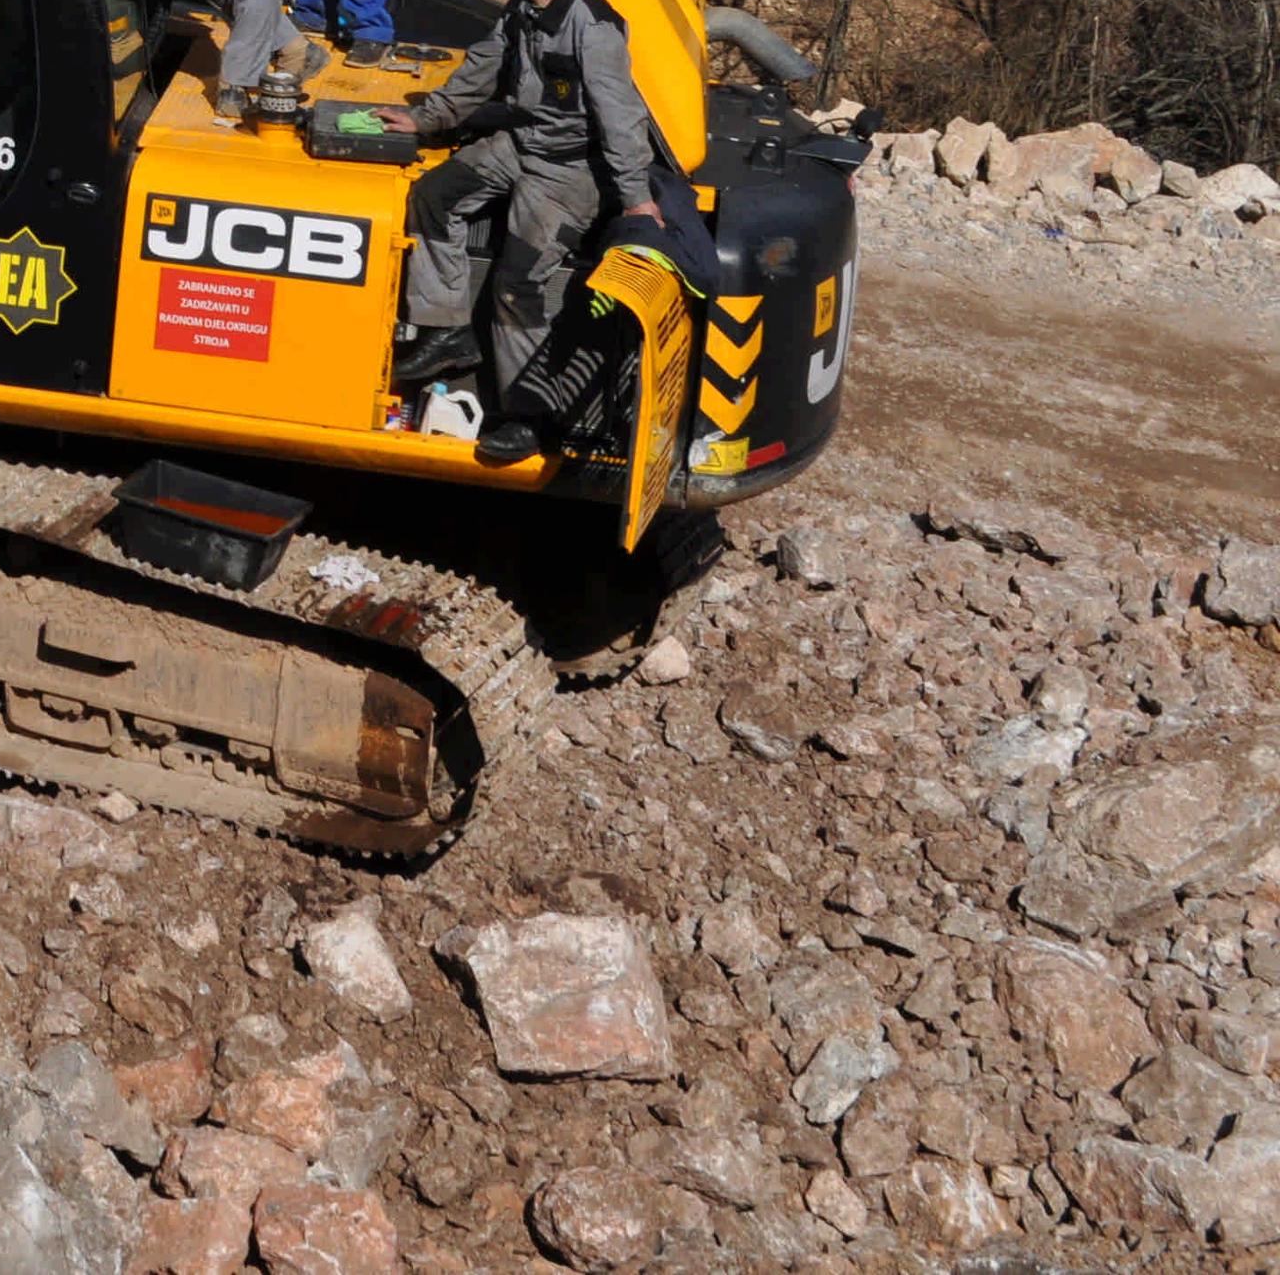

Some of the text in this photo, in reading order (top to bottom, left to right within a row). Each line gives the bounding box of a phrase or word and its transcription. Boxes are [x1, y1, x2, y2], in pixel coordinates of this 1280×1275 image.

[147, 203, 364, 279] JCB
[177, 280, 255, 298] ZABRANJENO SE
[180, 298, 250, 315] ZADRŽAVATI U
[159, 313, 268, 335] RADNOM DJELOKRUGU
[193, 334, 230, 348] STROJA
